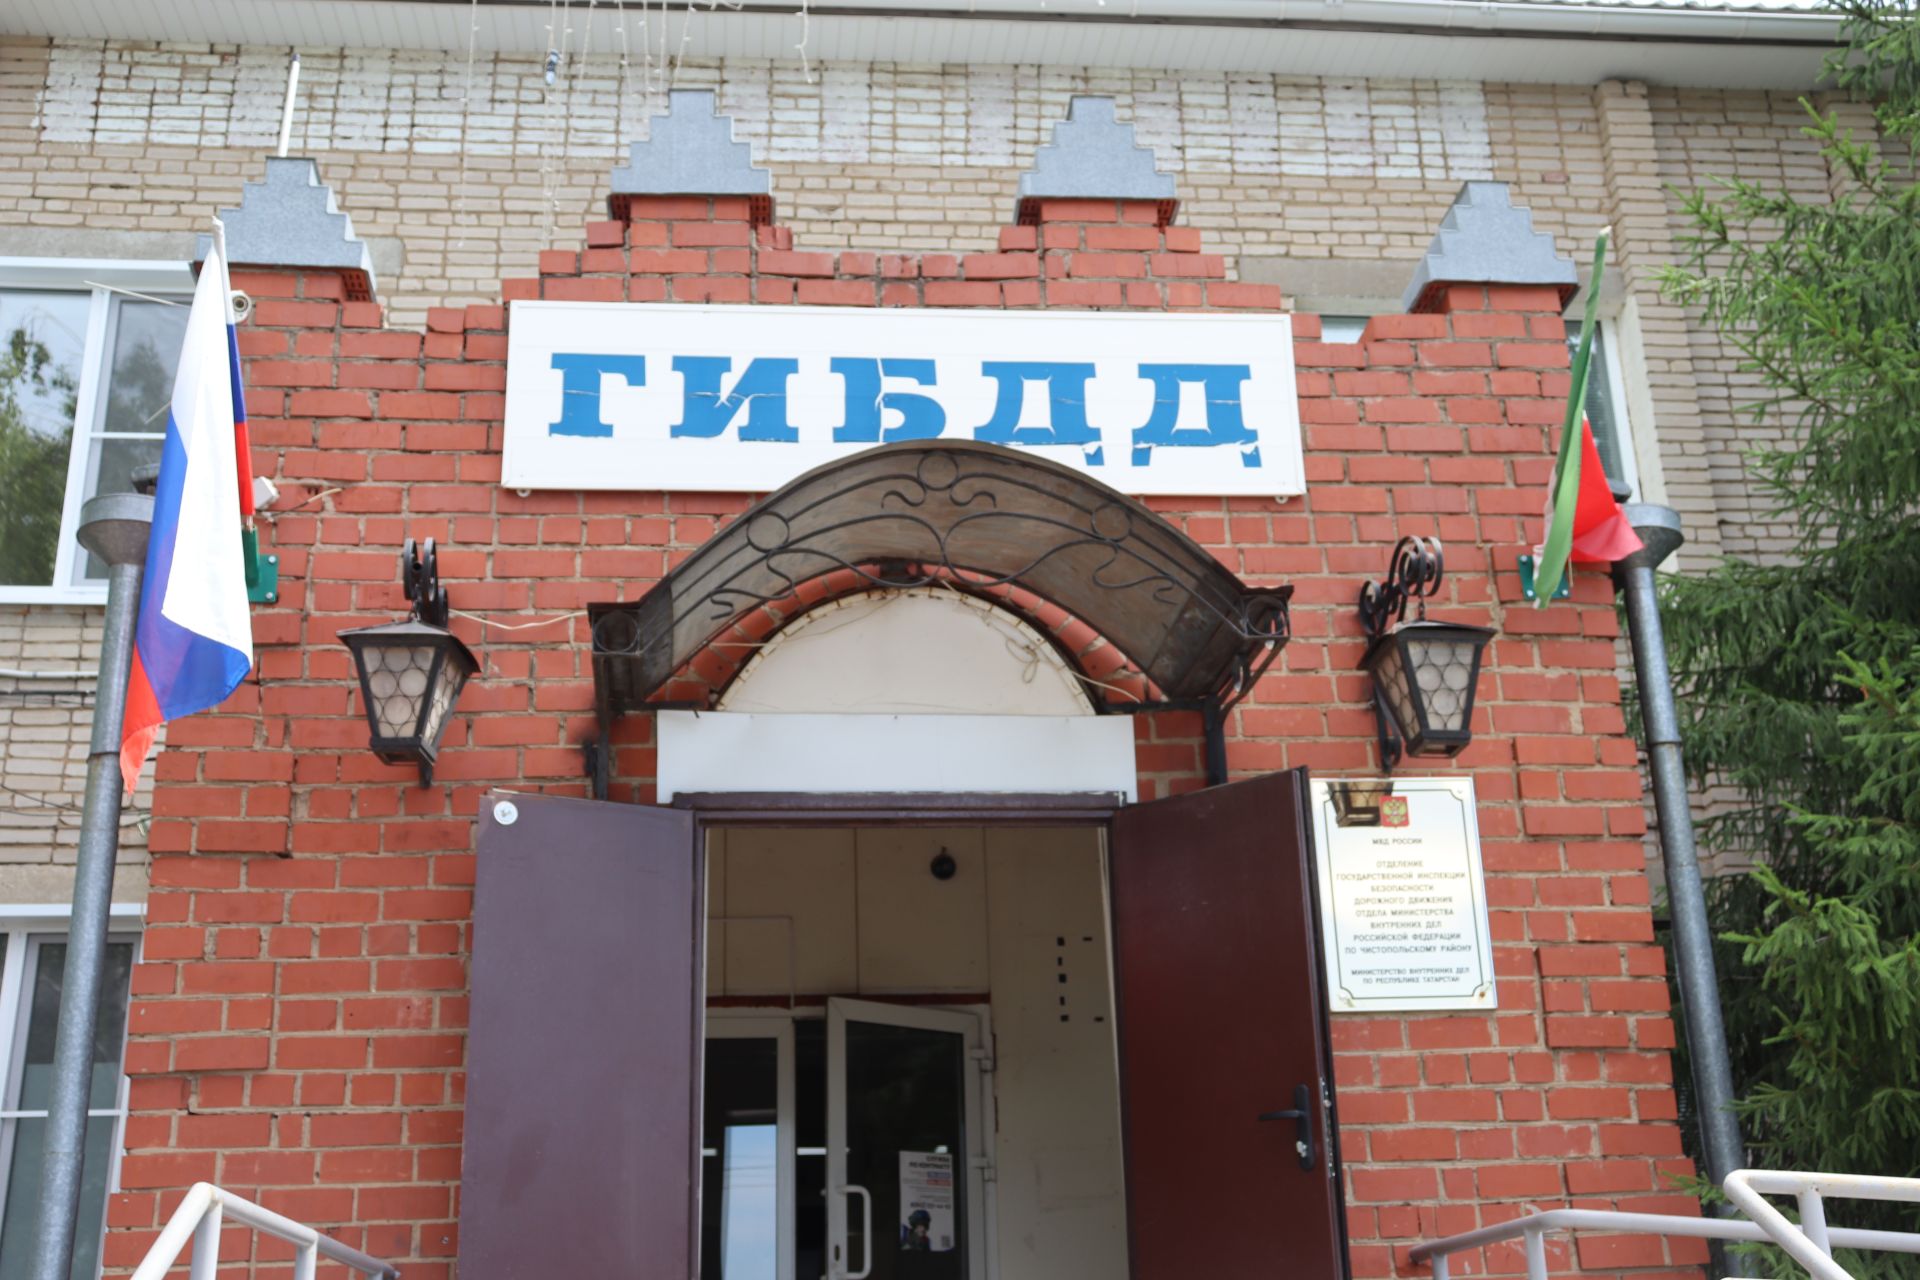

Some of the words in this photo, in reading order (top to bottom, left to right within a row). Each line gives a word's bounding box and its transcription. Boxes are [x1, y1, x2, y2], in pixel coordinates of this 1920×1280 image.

[548, 351, 1262, 467] ГИБДД
[1376, 860, 1423, 868] ОТДЕЛЕНИЕ
[1336, 872, 1413, 880] ГОСУДАРСТВЕННОЙ
[1417, 872, 1465, 880] ИНСПЕКЦИИ
[1371, 884, 1434, 892] БЕЗОПАСНОСТИ
[1354, 897, 1405, 905] ДОРОЖНОГО
[1355, 909, 1387, 917] ОТДЕЛА
[1370, 921, 1421, 929] ВНУТРЕННИХ
[1425, 921, 1442, 929] ДЕЛ
[1353, 933, 1408, 941] РОССИЙСКОЙ
[1412, 933, 1461, 941] ФЕДЕРАЦИИ
[1345, 946, 1357, 954] ПО
[1360, 945, 1436, 954] ЧИСТОПОЛЬСКОМУ
[1440, 944, 1472, 952] РАЙОНУ
[1351, 968, 1406, 976] МИНИСТЕРСТВО
[1409, 967, 1453, 975] ВНУТРЕННИХ
[1456, 967, 1470, 975] ДЕЛ
